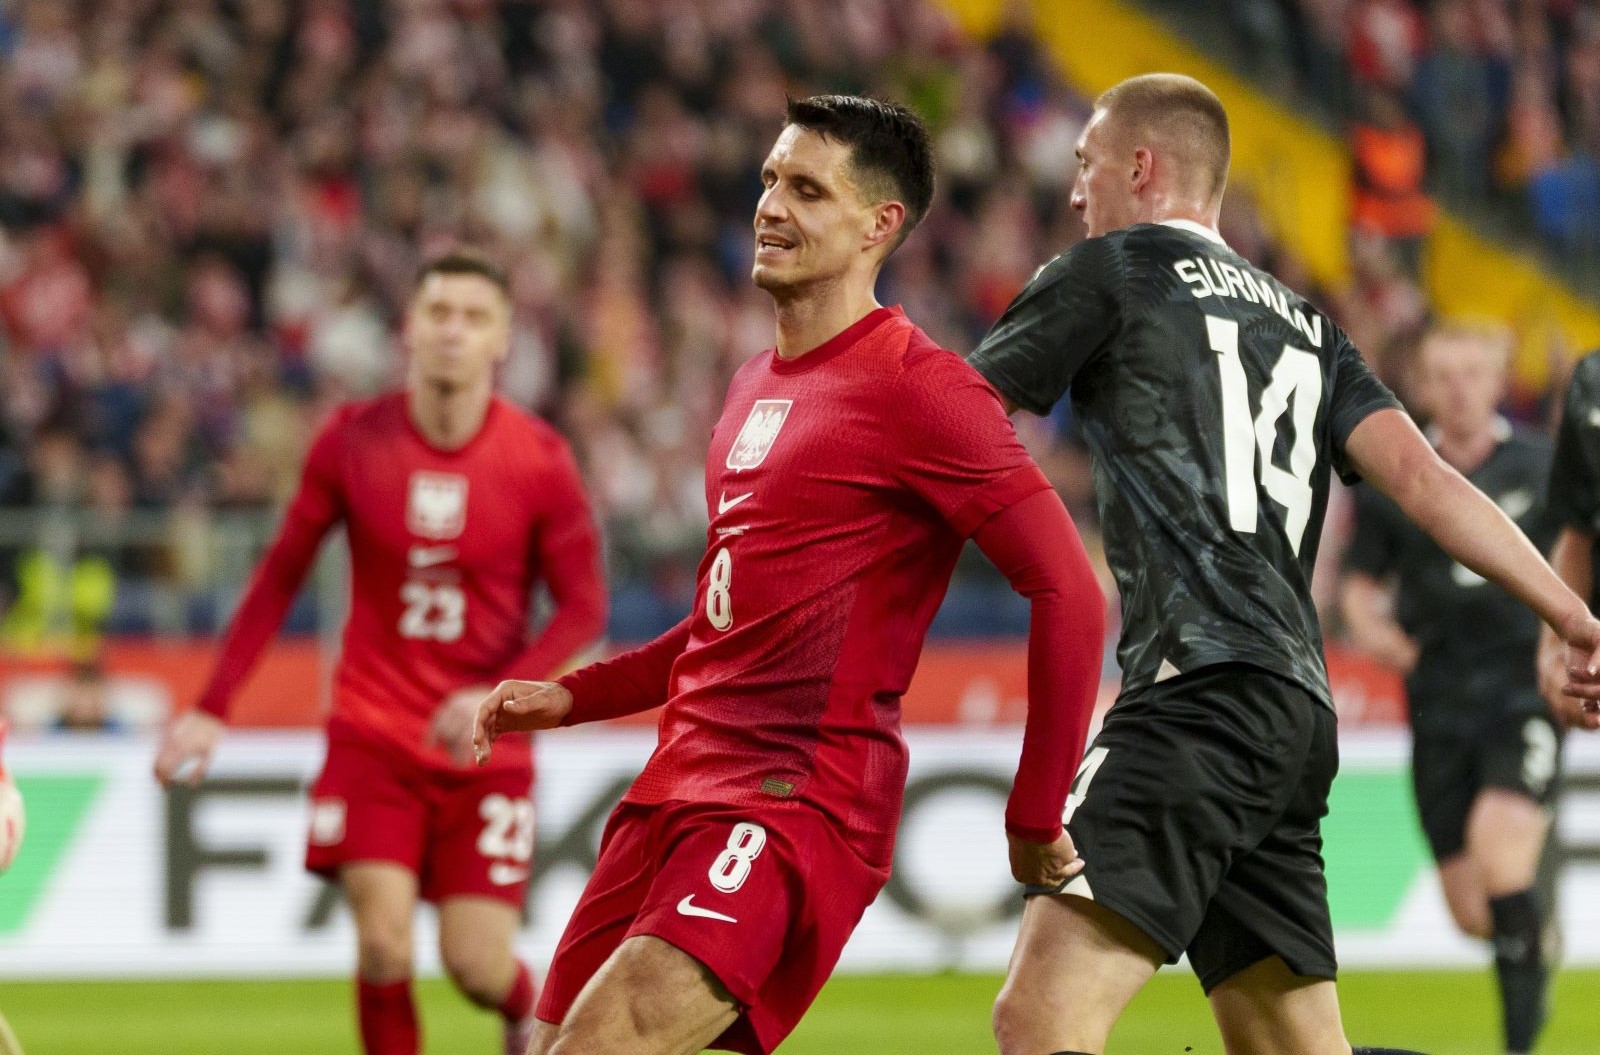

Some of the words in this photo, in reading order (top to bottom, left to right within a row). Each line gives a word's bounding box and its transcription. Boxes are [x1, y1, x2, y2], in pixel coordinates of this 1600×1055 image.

[1205, 314, 1322, 558] 14
[398, 581, 465, 643] 23
[706, 548, 733, 632] 8
[708, 822, 767, 893] 8
